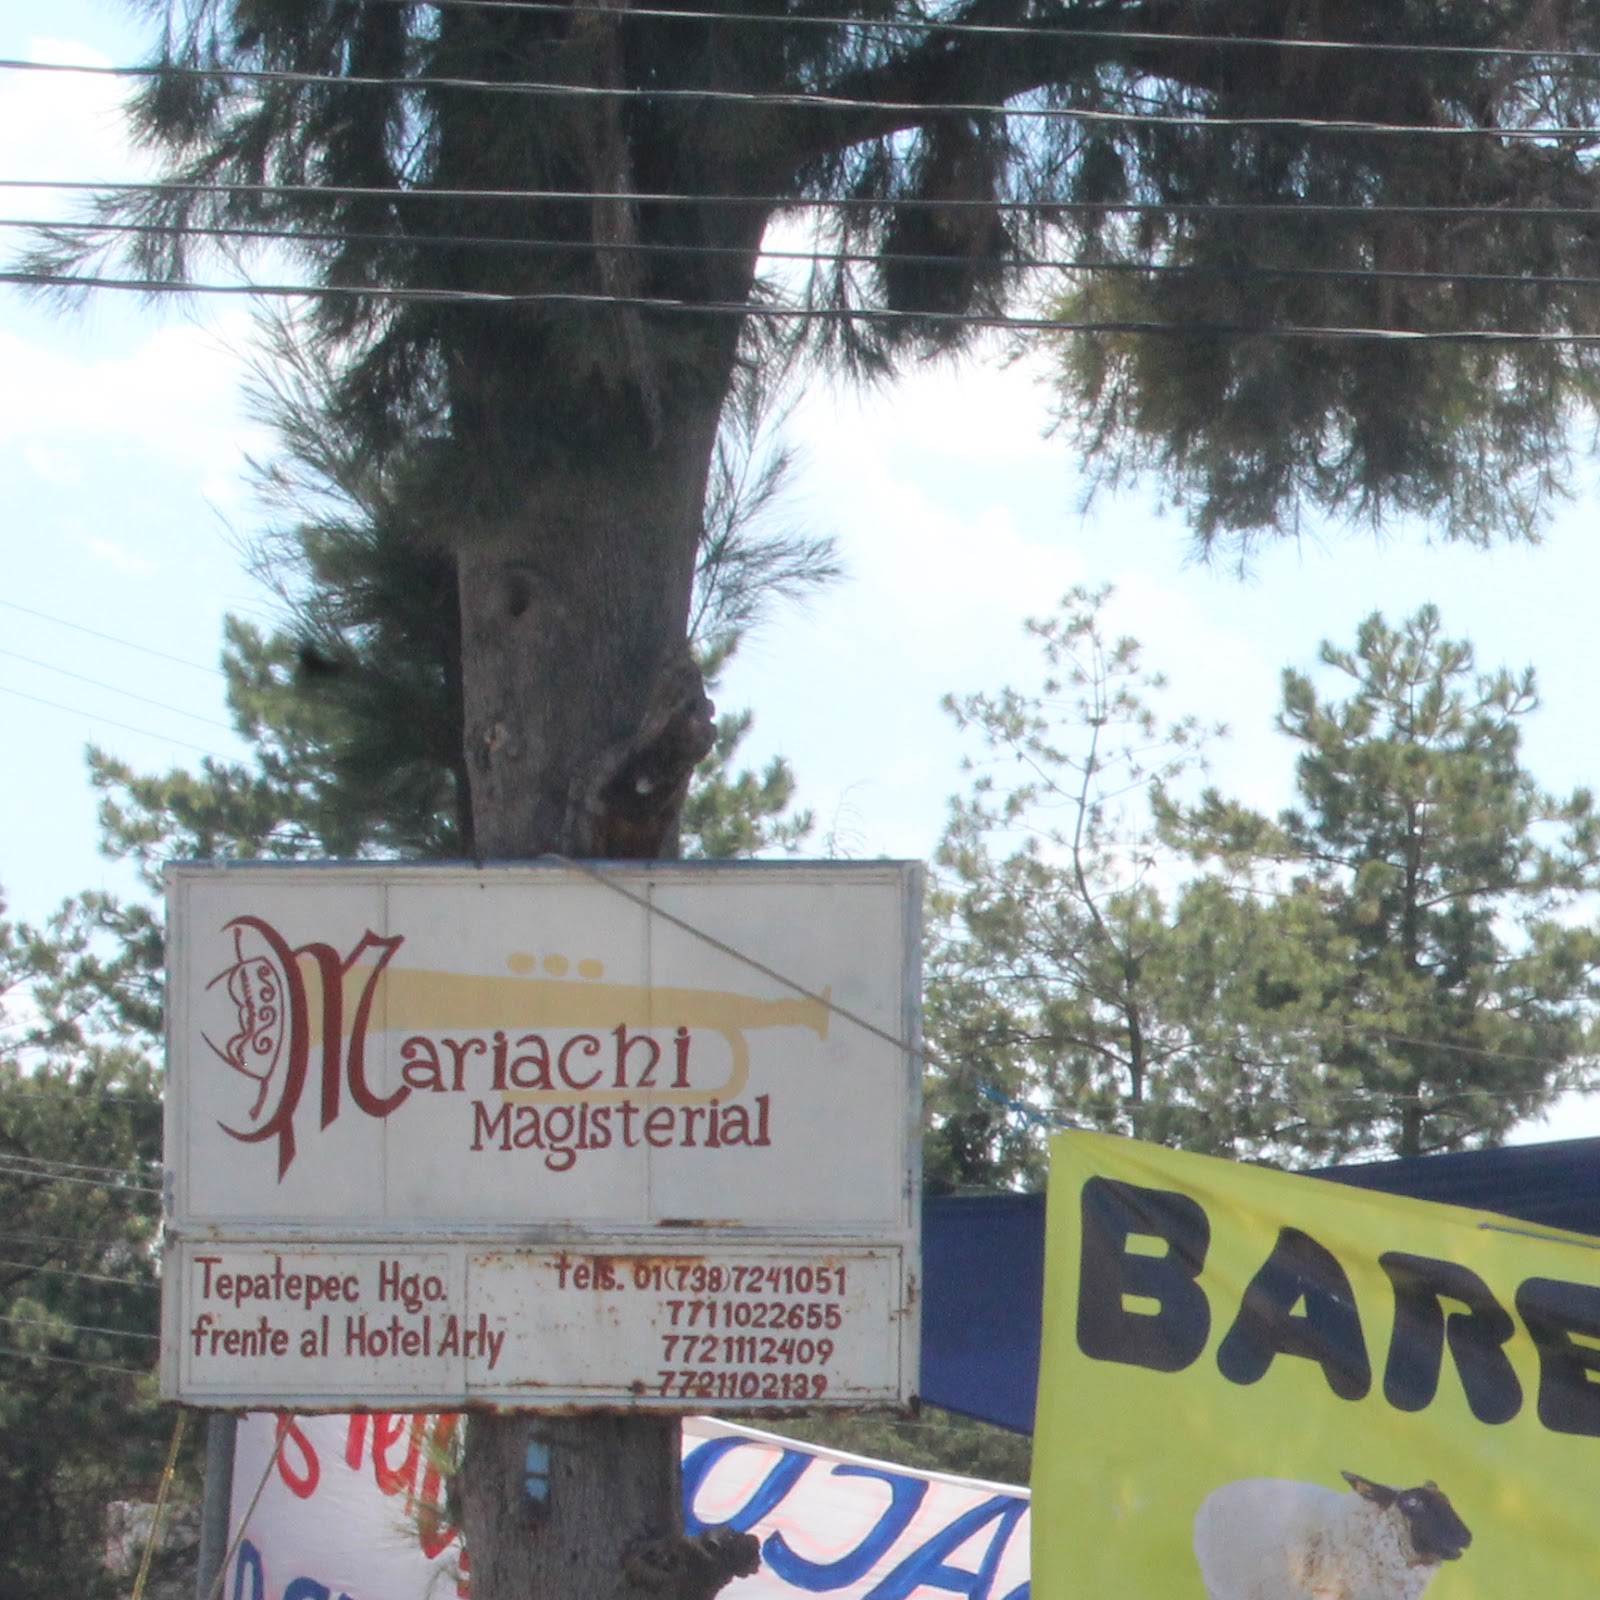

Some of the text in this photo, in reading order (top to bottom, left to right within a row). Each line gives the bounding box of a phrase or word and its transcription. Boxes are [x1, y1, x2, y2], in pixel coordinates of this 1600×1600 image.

[217, 914, 692, 1184] Mariachi
[470, 1094, 771, 1172] Magisterial
[195, 1256, 447, 1314] Tepatepec Hgo.
[192, 1313, 505, 1370] frente al Hotel Arly
[668, 1301, 842, 1331] 7711022655
[663, 1335, 834, 1365] 7721112409
